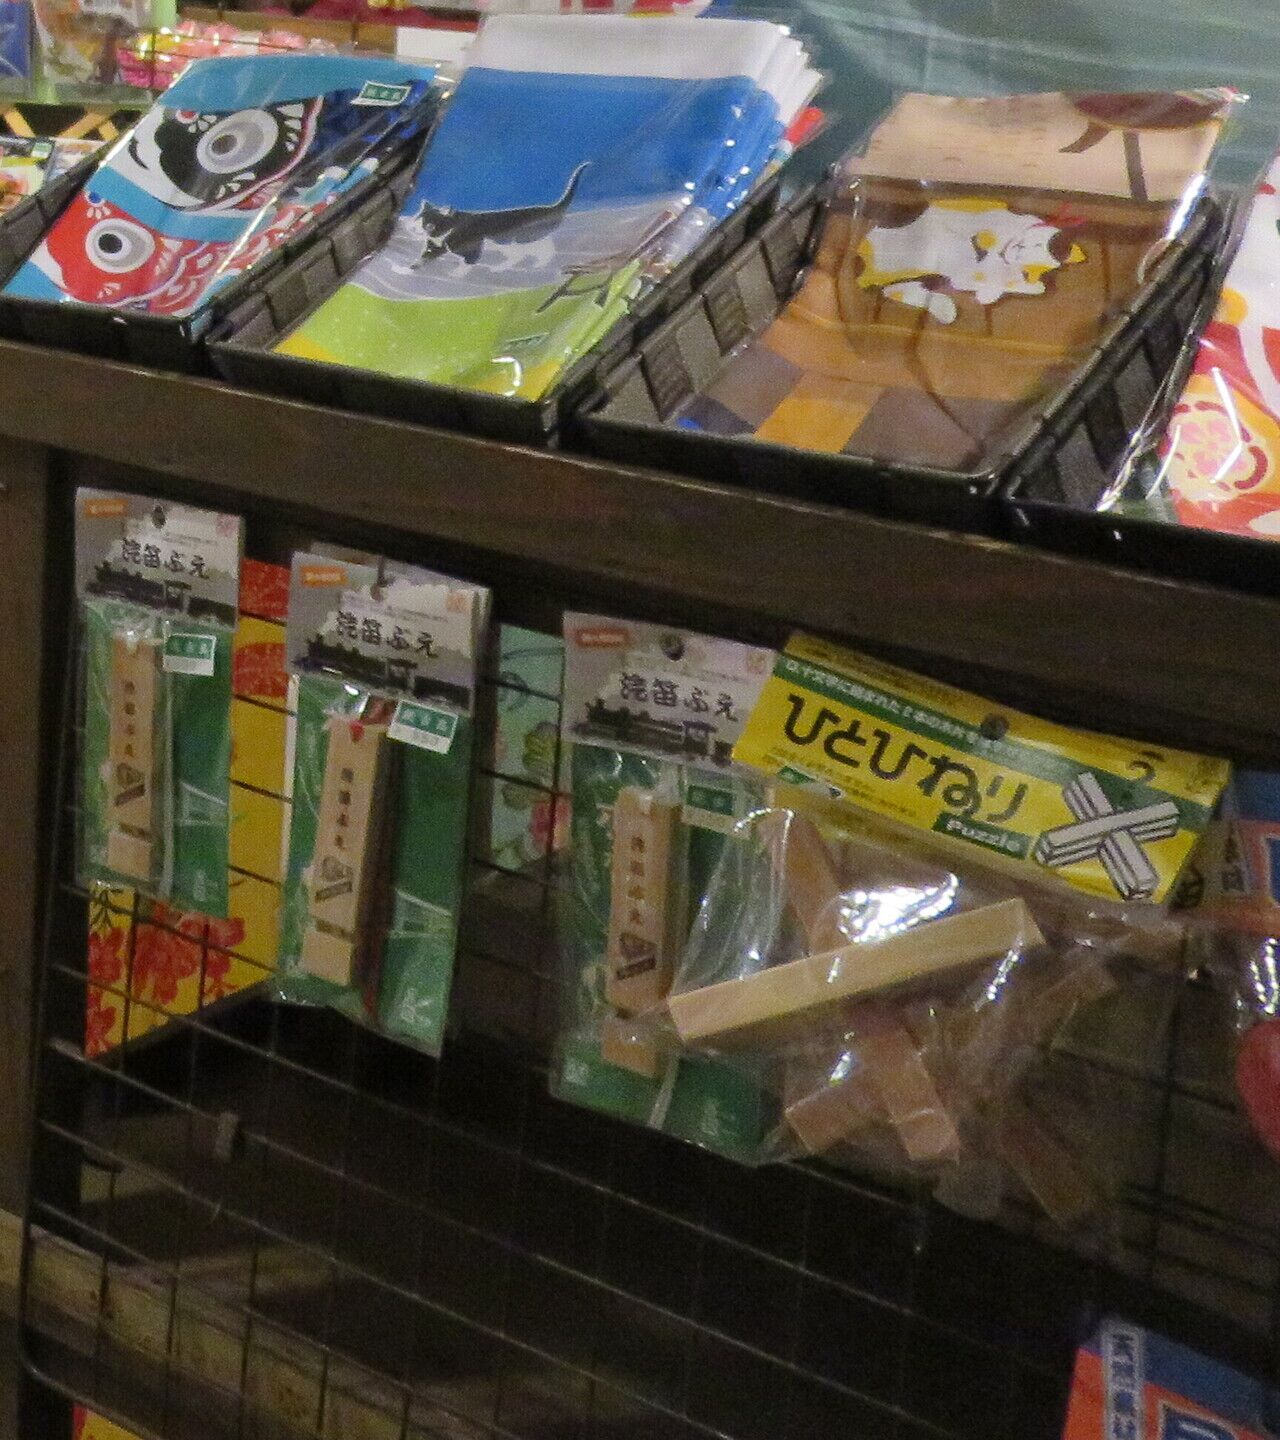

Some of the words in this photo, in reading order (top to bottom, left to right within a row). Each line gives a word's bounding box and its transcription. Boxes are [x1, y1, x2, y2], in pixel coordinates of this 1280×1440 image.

[785, 692, 1028, 823] ひとひねり
